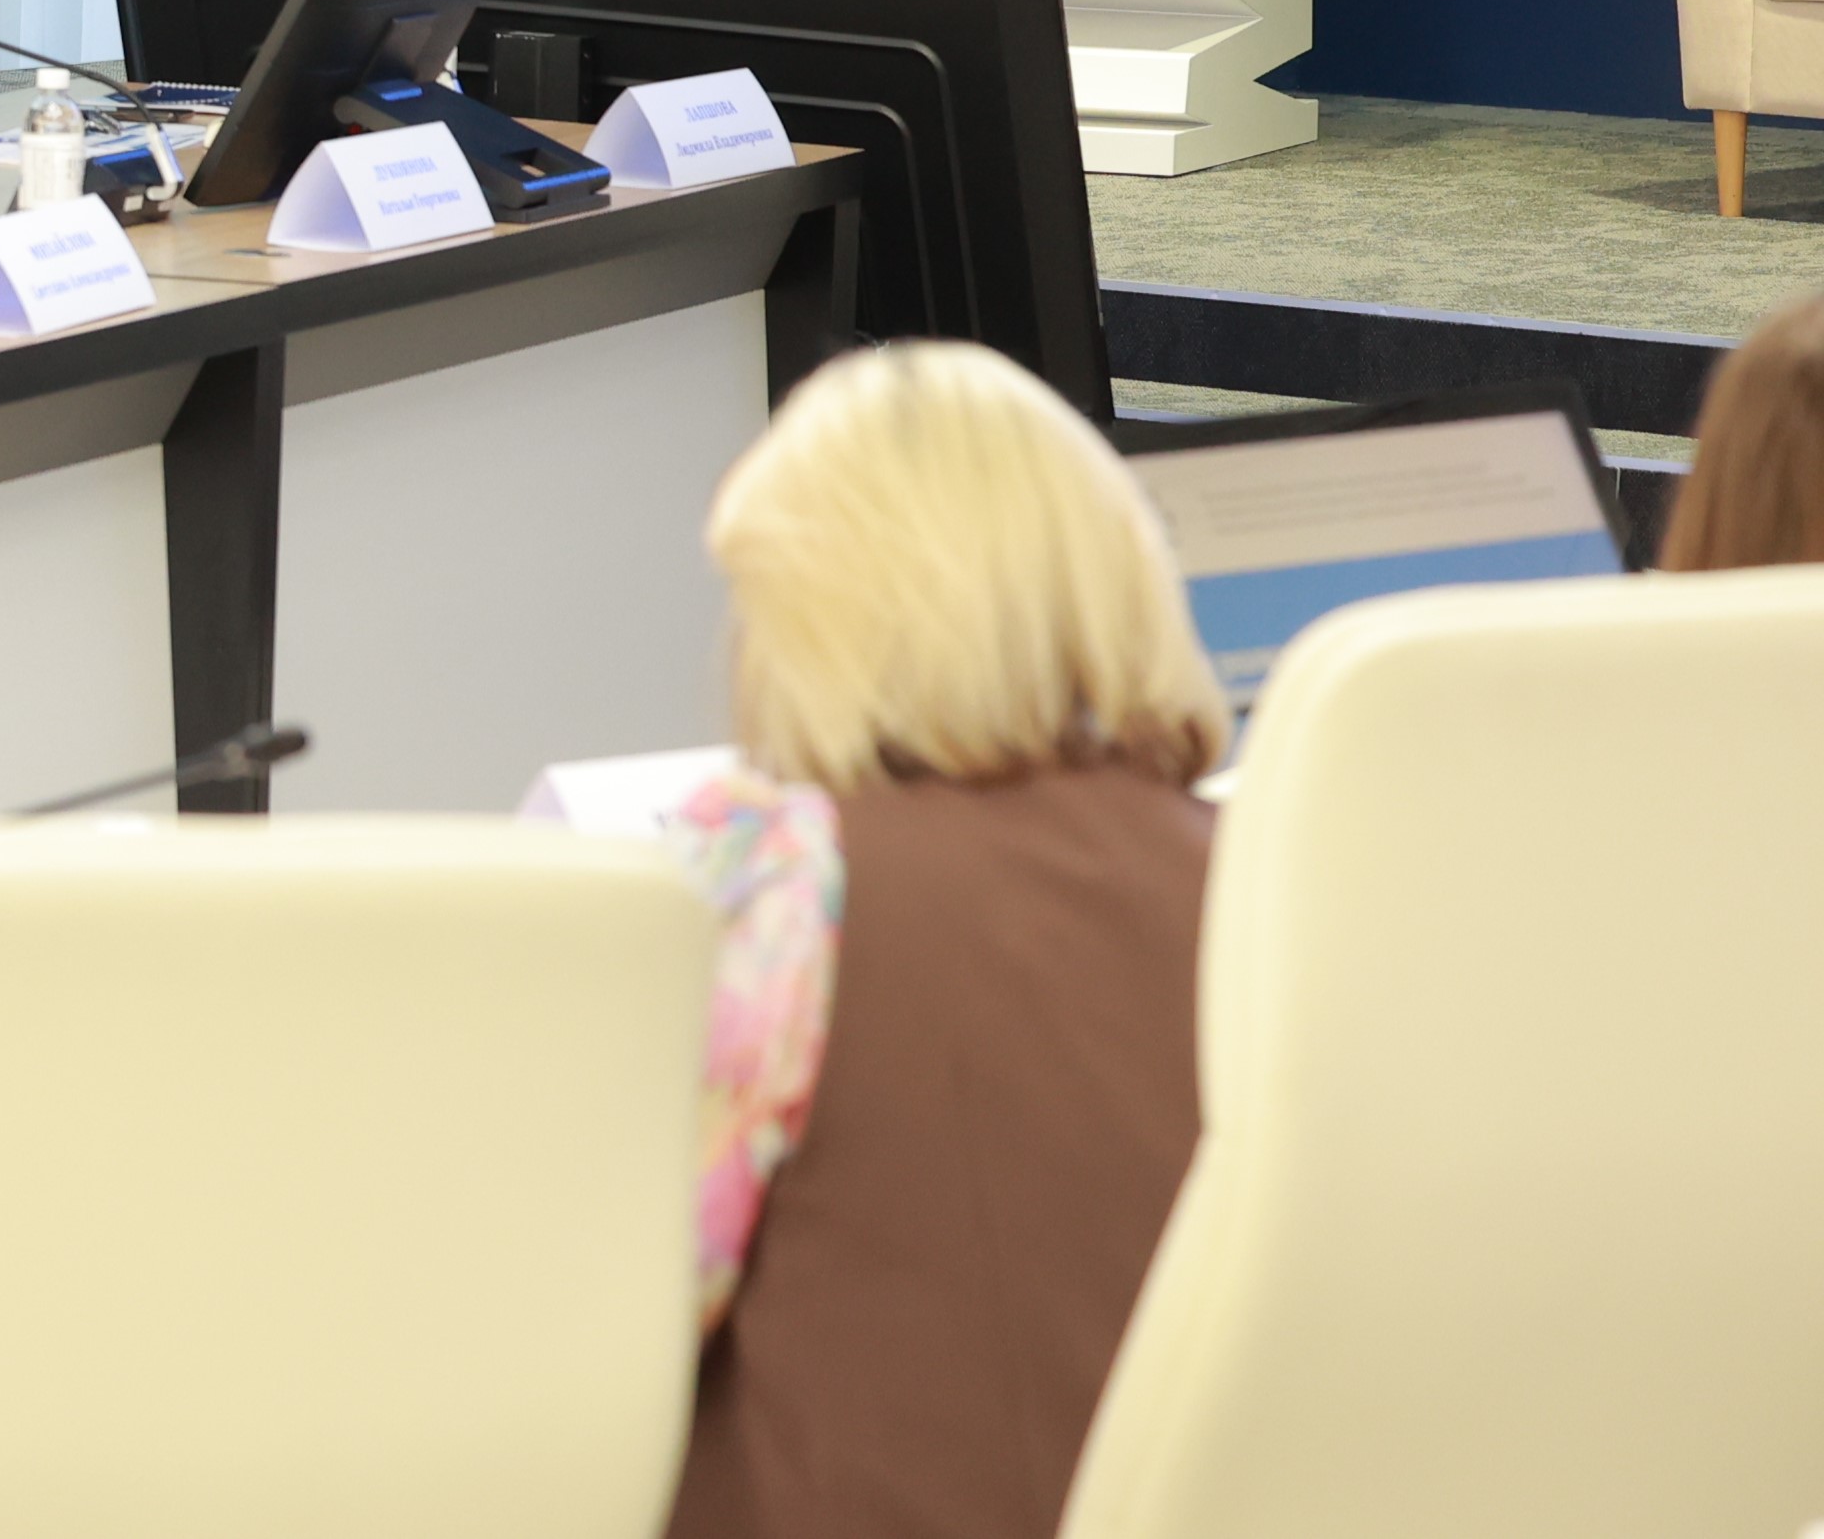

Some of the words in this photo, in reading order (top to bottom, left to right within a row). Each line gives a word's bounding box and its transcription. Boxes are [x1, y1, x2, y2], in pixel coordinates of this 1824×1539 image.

[684, 100, 738, 123] ЛАПШОВА
[676, 141, 714, 158] Людмила
[713, 128, 774, 148] Владимировна
